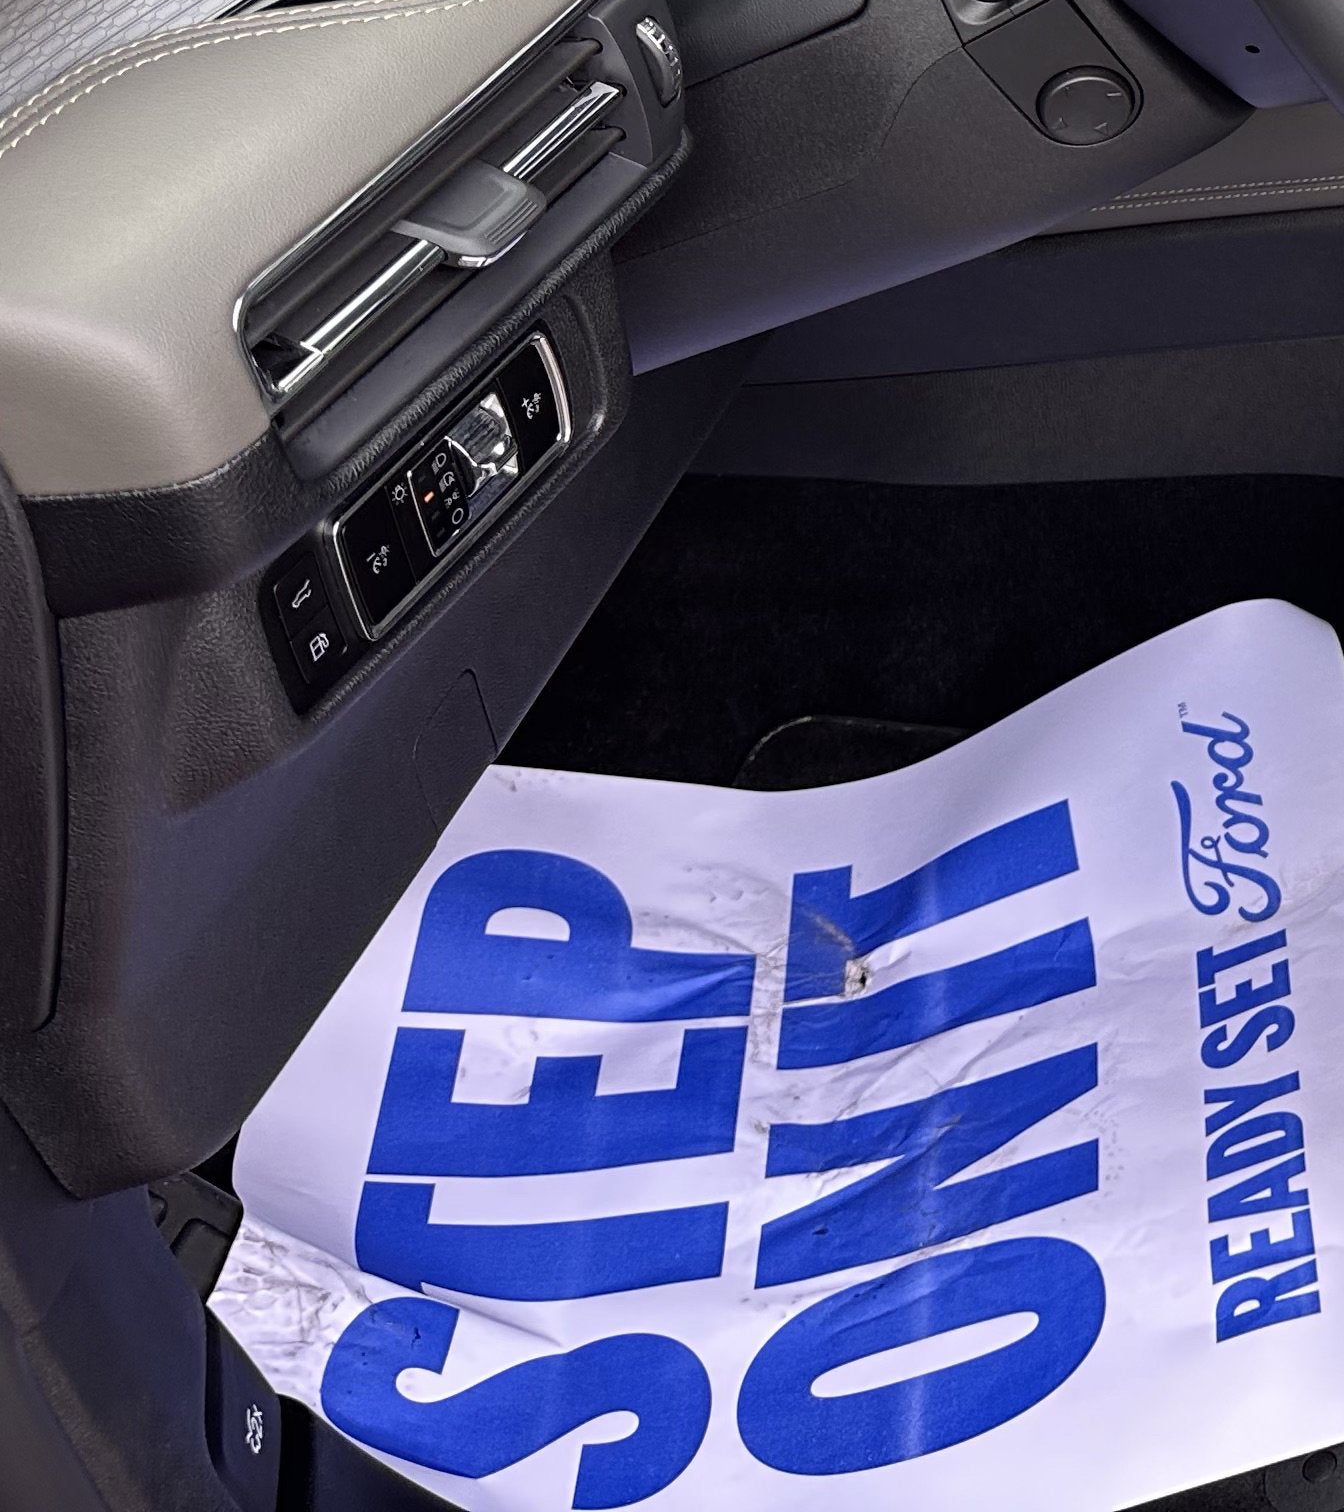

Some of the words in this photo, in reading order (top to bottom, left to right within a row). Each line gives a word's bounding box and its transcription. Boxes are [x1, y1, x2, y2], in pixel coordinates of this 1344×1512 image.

[776, 800, 1098, 1071] IT
[1196, 930, 1295, 1070] SET
[320, 849, 757, 1511] STEP
[737, 1043, 1106, 1477] ON
[1204, 1071, 1321, 1341] READY
